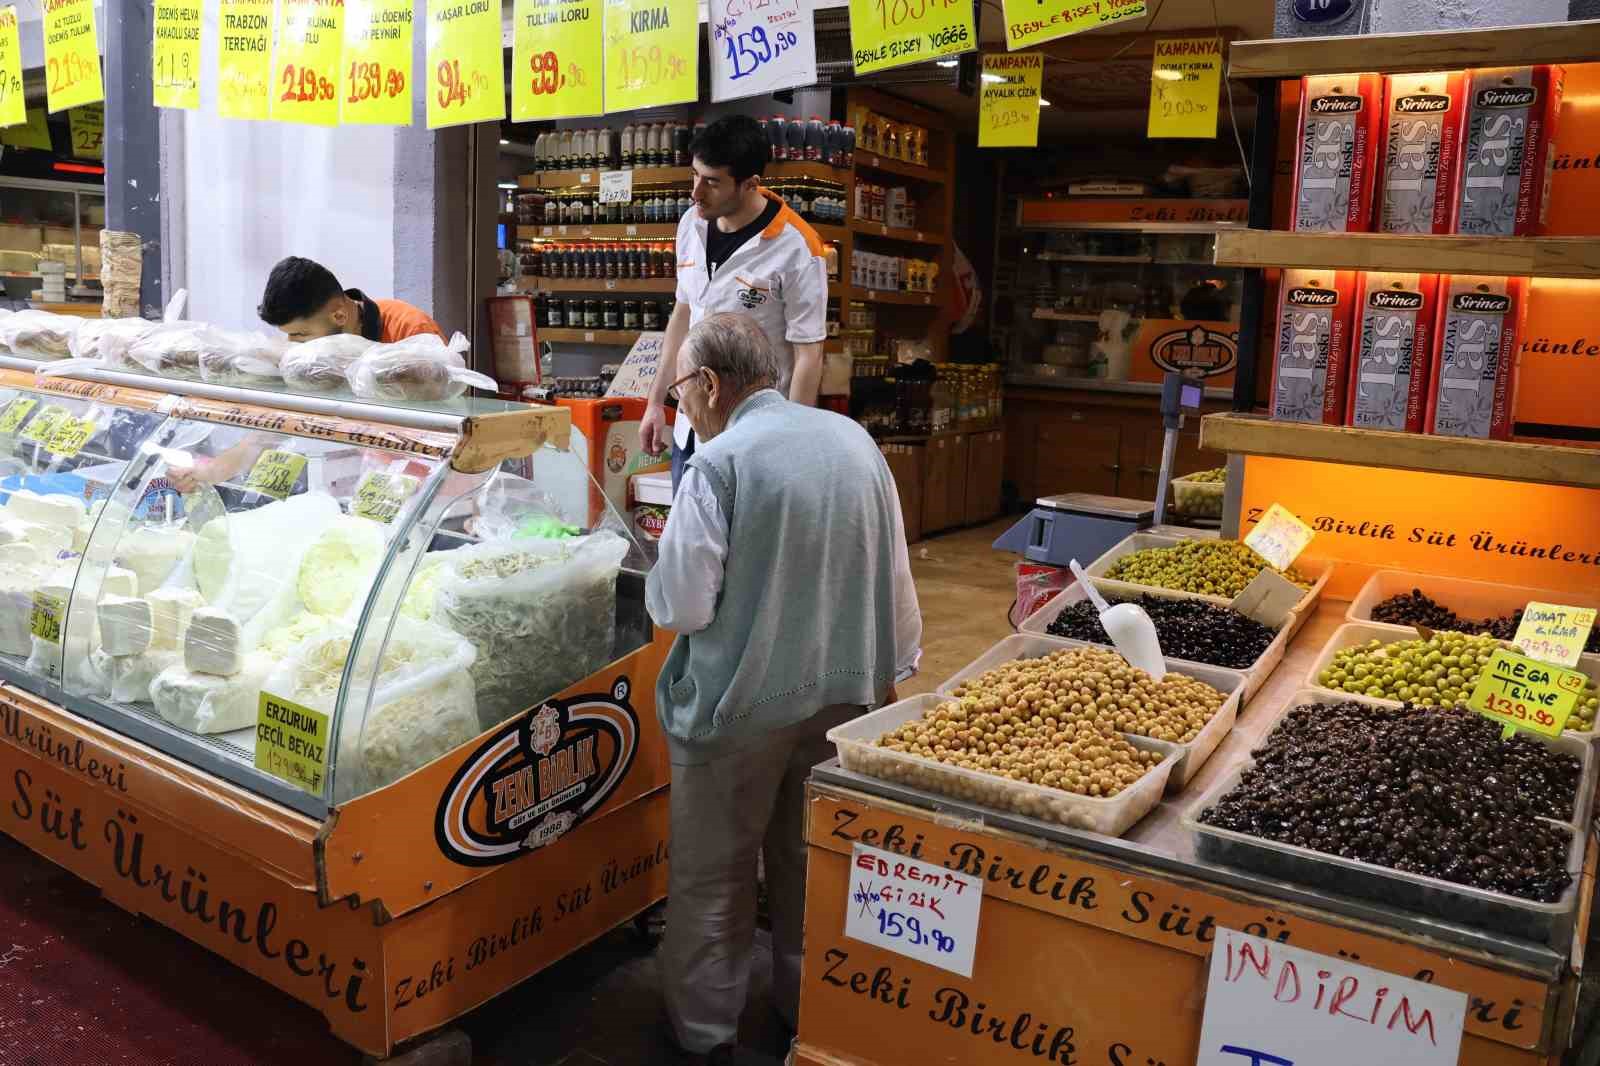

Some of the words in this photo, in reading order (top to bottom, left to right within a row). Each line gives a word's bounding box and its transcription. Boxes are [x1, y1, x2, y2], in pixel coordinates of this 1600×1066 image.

[180, 9, 199, 21] HELVA
[224, 15, 268, 30] TRABZON
[436, 7, 463, 23] KAŞAR
[465, 1, 490, 15] LORU
[561, 8, 590, 23] LORU
[630, 7, 670, 33] KIRMA
[223, 34, 268, 52] TEREYAĞI
[370, 26, 401, 40] PEYNİRİ
[726, 25, 798, 80] 159,90
[855, 46, 888, 68] BÖYLE
[984, 55, 1041, 70] KAMPANYA
[1157, 41, 1220, 57] KAMPANYA
[1311, 516, 1398, 540] Birlik
[1408, 527, 1458, 548] Süt
[1497, 660, 1550, 686] MEGA
[265, 701, 319, 737] ERZURUM
[0, 693, 129, 792] Ürünleri
[256, 723, 286, 749] ÇEÇİL
[288, 735, 324, 764] BEYAZ
[493, 765, 536, 825] ZEKİ
[538, 735, 597, 801] BİRLİK
[11, 768, 88, 851] Süt
[104, 807, 368, 1013] Ürünleri
[831, 809, 925, 859] Zeki
[943, 841, 1100, 911] Birlik
[1119, 889, 1218, 945] Süt
[877, 908, 955, 953] 159,90
[393, 958, 457, 1012] Zeki
[465, 905, 546, 970] Birlik
[553, 880, 594, 923] Süt
[821, 948, 912, 1010] Zeki
[929, 986, 1079, 1066] Birlik
